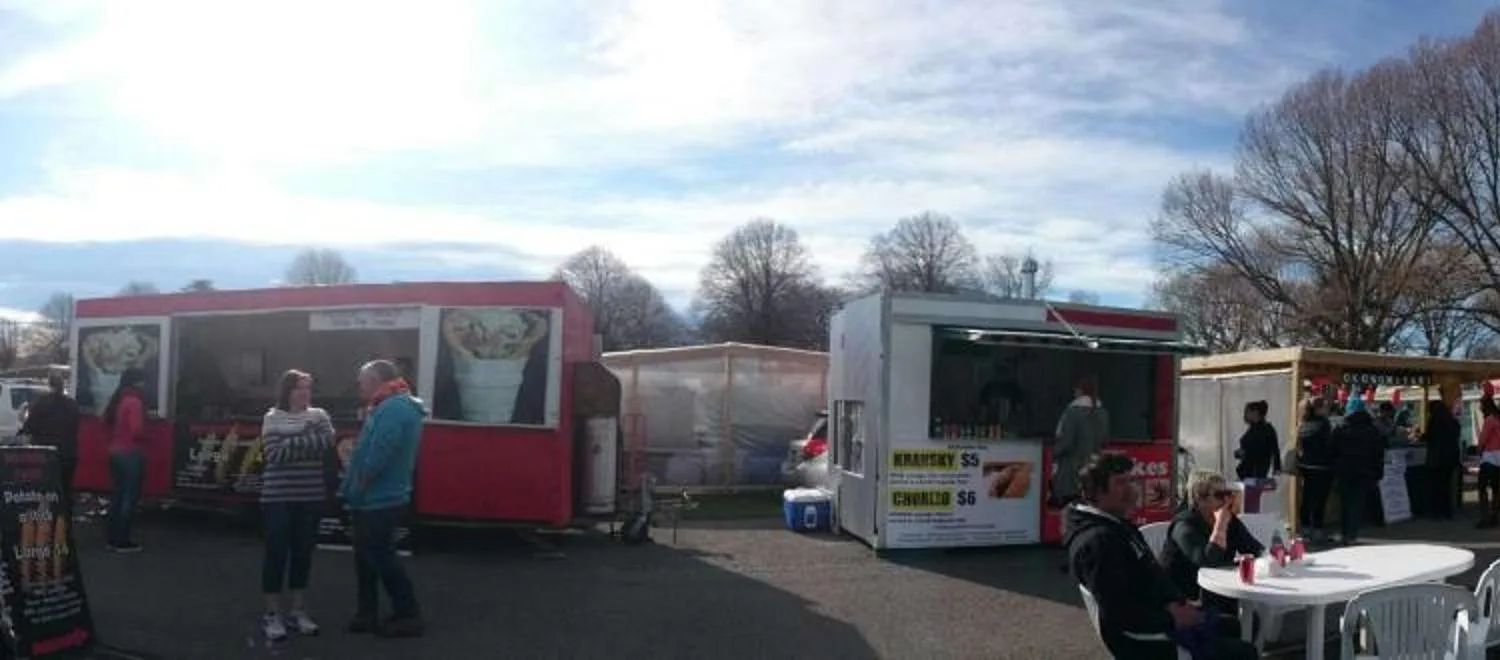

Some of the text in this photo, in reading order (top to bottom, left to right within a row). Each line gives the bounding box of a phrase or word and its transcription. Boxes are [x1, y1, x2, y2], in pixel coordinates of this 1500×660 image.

[893, 451, 980, 467] KRANSKY $5
[956, 490, 977, 506] $6
